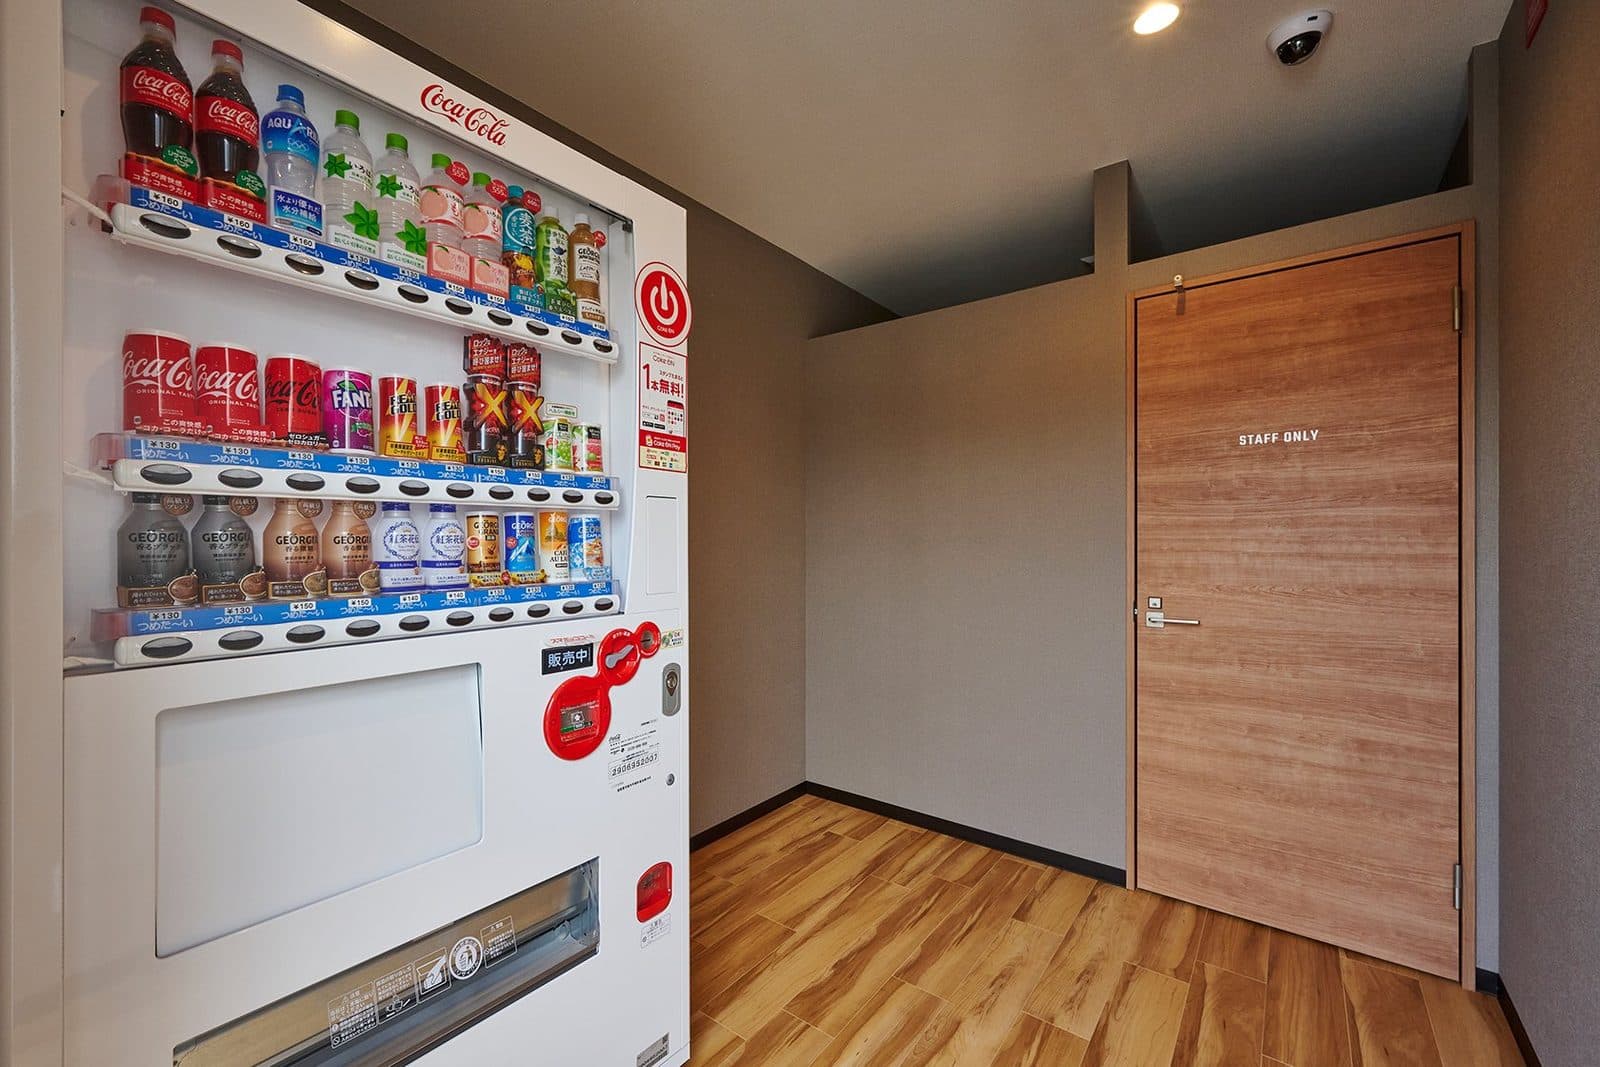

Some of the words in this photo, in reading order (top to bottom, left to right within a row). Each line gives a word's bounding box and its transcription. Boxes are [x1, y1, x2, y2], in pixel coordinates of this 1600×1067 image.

[133, 70, 190, 107] Coca-Cola
[208, 100, 258, 134] Coca-Cola
[420, 84, 511, 146] Coca-Cola
[152, 192, 180, 207] ¥160
[227, 216, 251, 229] ¥160
[292, 236, 313, 248] ¥160
[136, 388, 176, 396] ORIGINAL
[331, 389, 373, 410] FANT
[289, 434, 327, 442] ゼロシュガー
[1239, 432, 1280, 446] STAFF
[1283, 429, 1319, 444] ONLY
[150, 441, 178, 450] ¥130
[225, 447, 250, 455] ¥130
[291, 452, 312, 460] ¥130
[292, 601, 314, 610] ¥150
[351, 599, 370, 607] ¥150
[152, 611, 180, 620] ¥130
[226, 606, 251, 615] ¥130
[547, 648, 588, 668] 販売中
